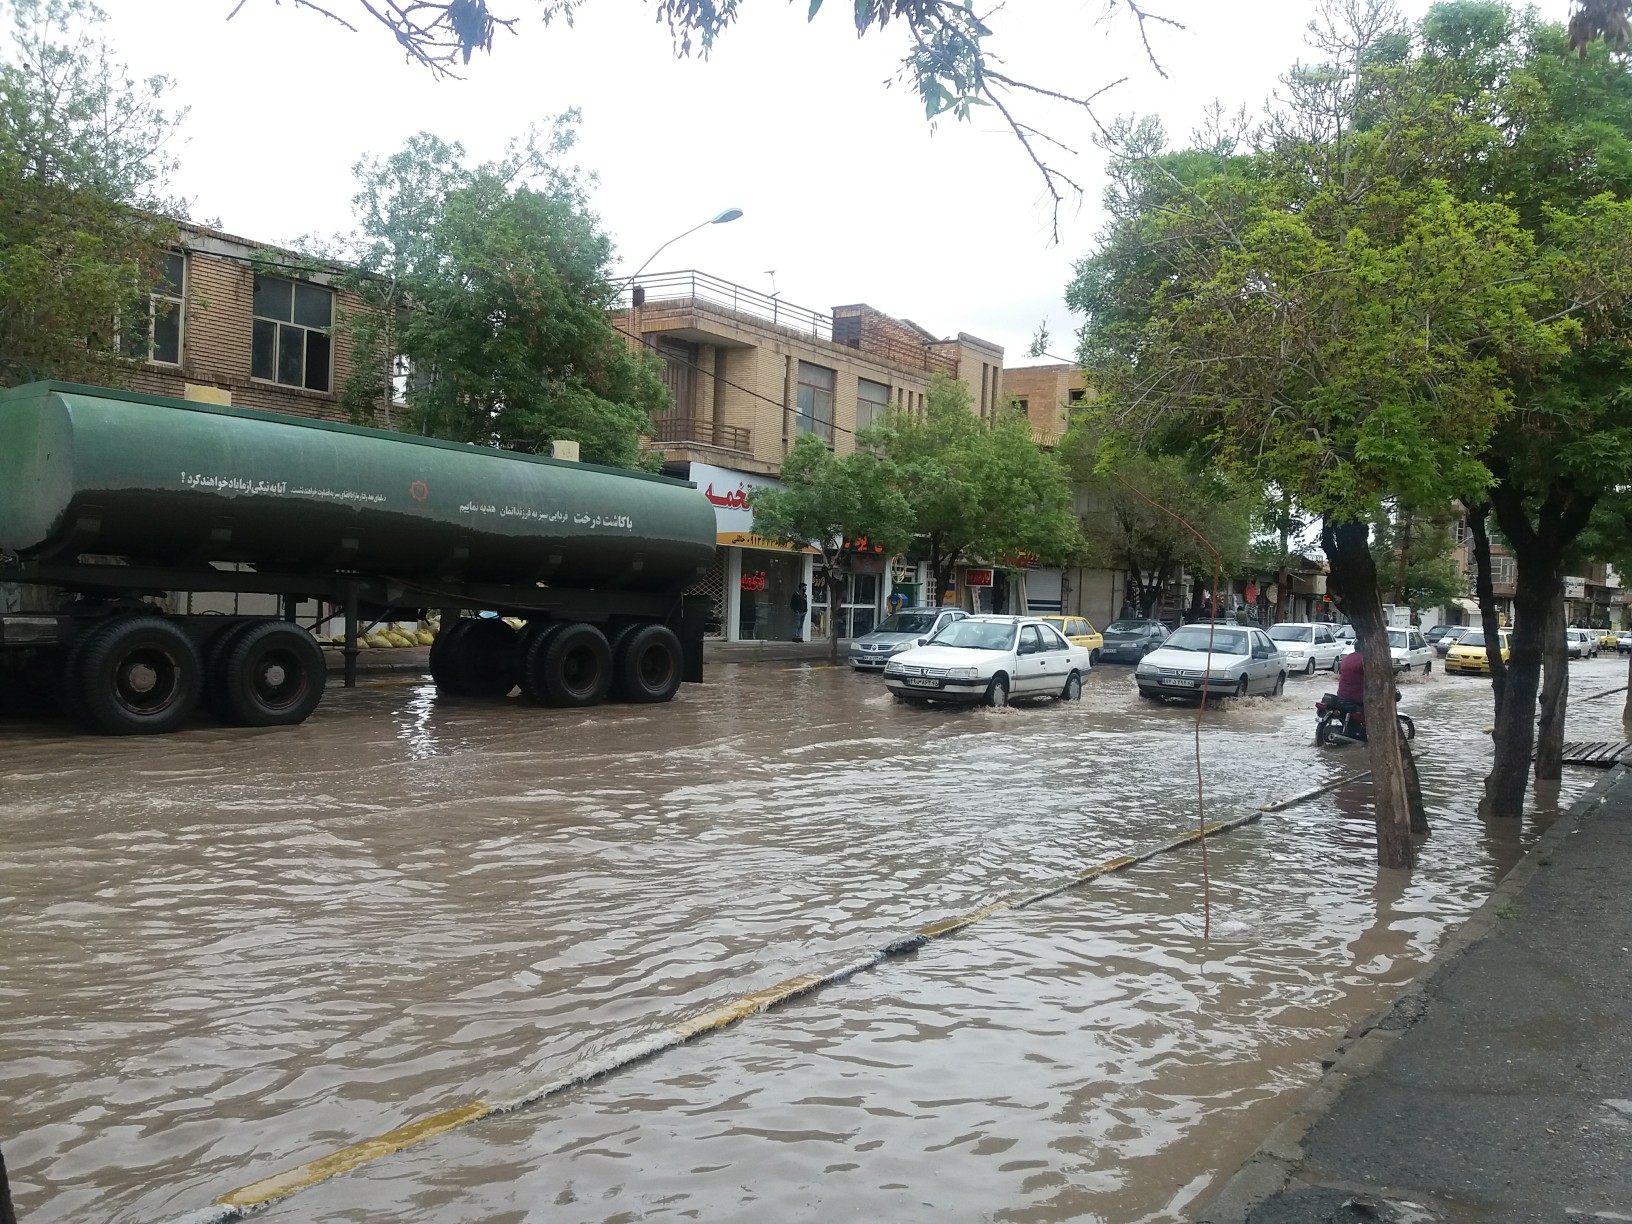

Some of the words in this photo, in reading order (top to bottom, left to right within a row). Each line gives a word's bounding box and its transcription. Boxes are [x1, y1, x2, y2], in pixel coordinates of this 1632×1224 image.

[187, 473, 201, 489] کرد
[200, 475, 229, 491] خواهند
[228, 477, 240, 492] یاد
[244, 479, 252, 494] از
[251, 480, 270, 495] نیکی
[277, 481, 287, 496] آیا
[270, 482, 277, 496] به
[459, 500, 479, 514] نماییم
[479, 503, 496, 515] هدیه
[531, 510, 538, 519] به
[538, 511, 549, 521] سبز
[573, 511, 602, 529] درخت
[602, 514, 627, 529] کاشت
[626, 515, 633, 532] با
